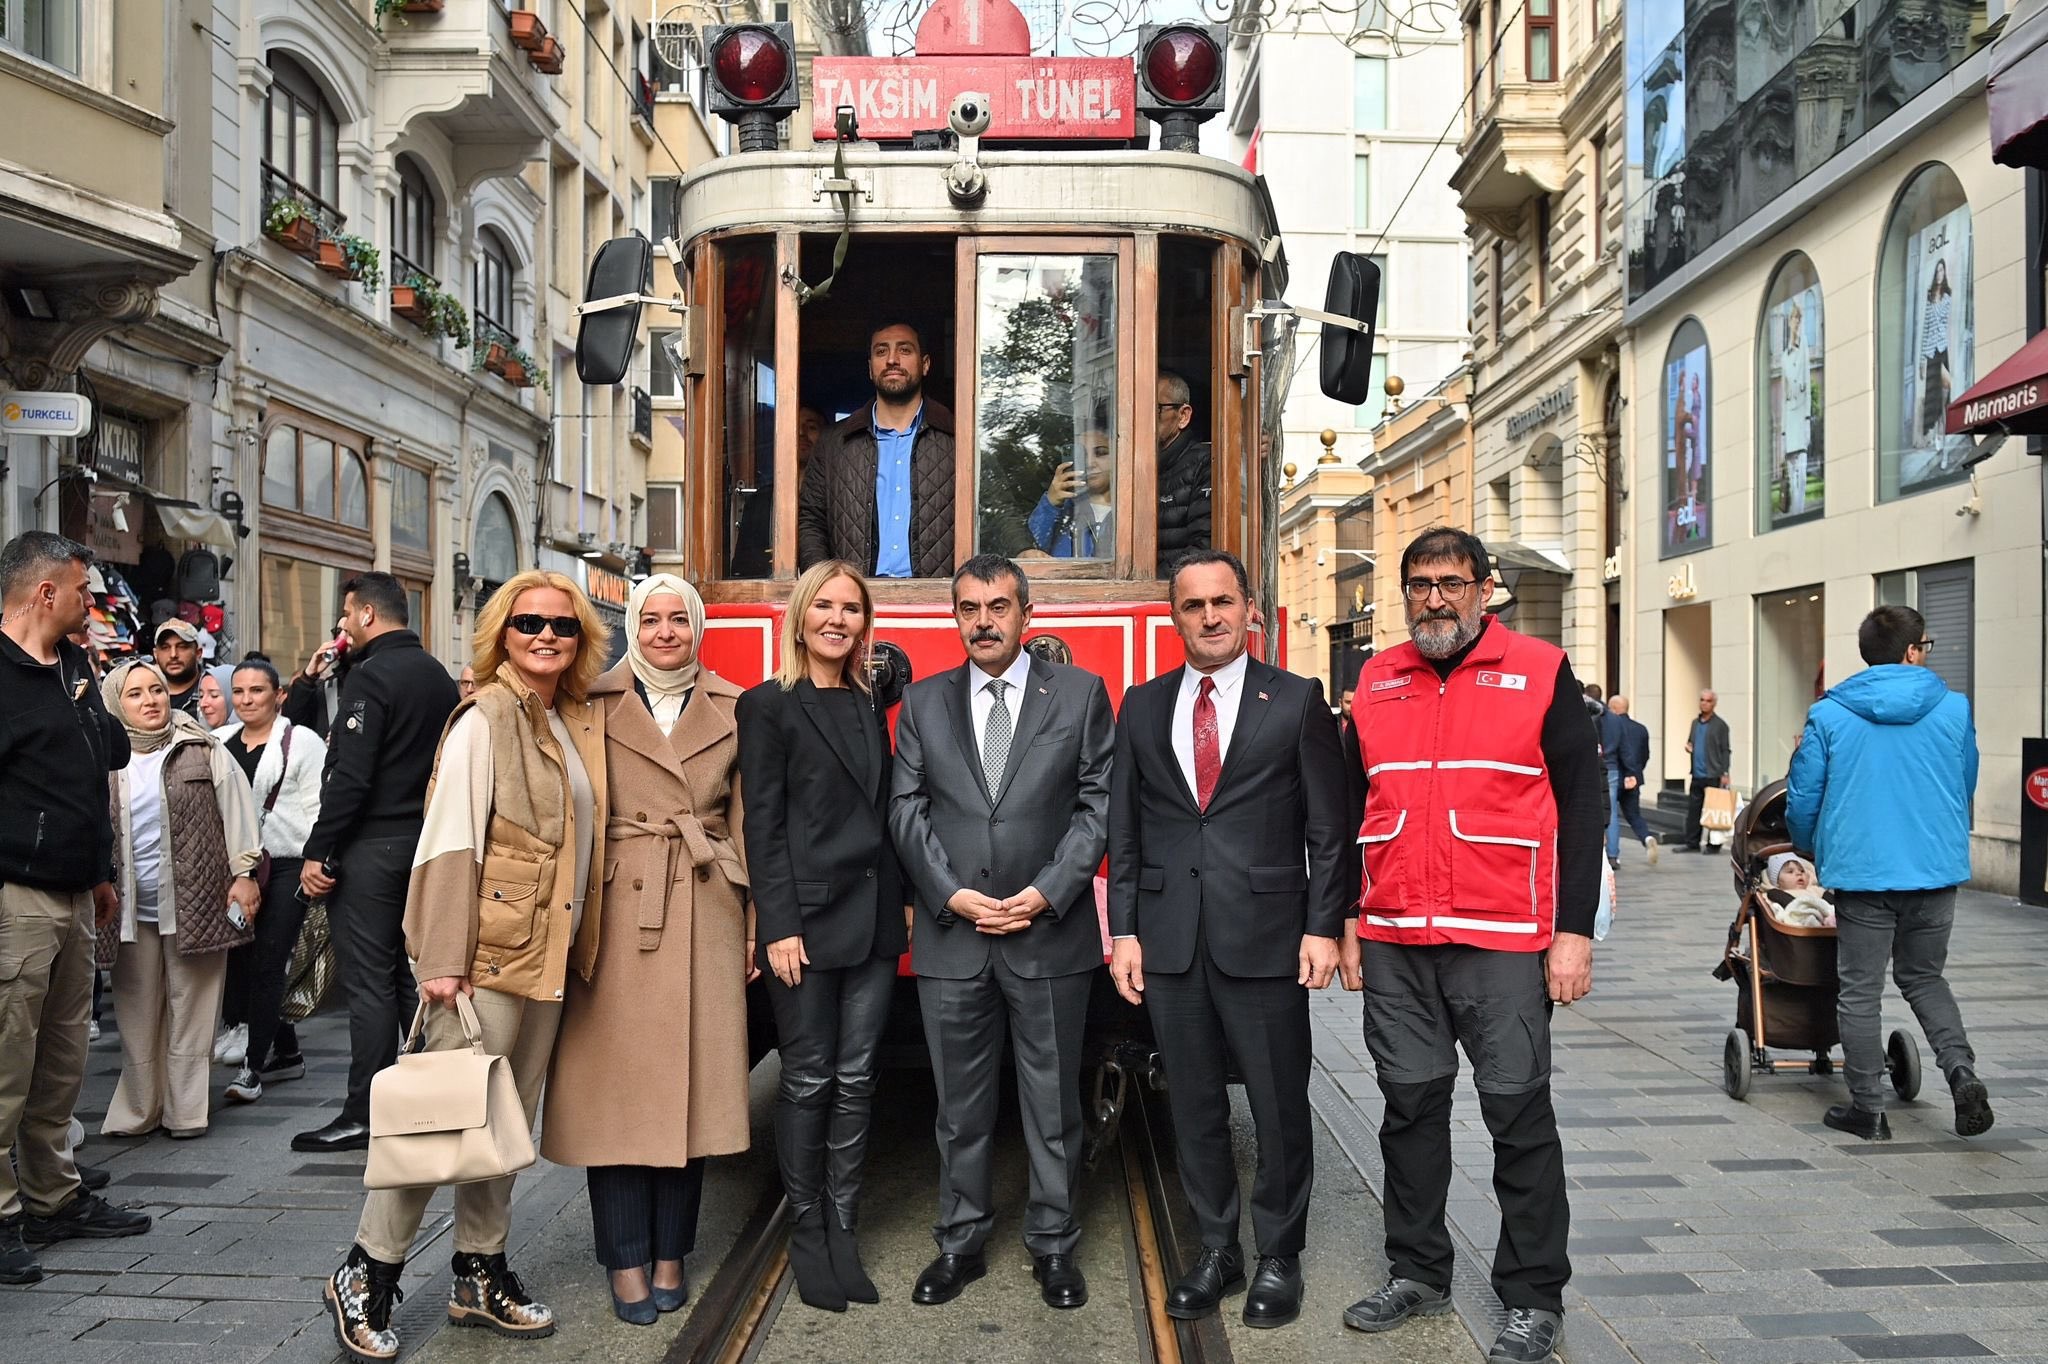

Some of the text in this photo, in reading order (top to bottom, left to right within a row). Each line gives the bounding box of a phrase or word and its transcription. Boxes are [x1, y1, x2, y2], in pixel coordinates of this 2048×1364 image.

[819, 67, 1121, 120] TAKSİM TÜNEL
[21, 409, 74, 421] TURKCELL
[1964, 384, 2038, 425] Marmaris
